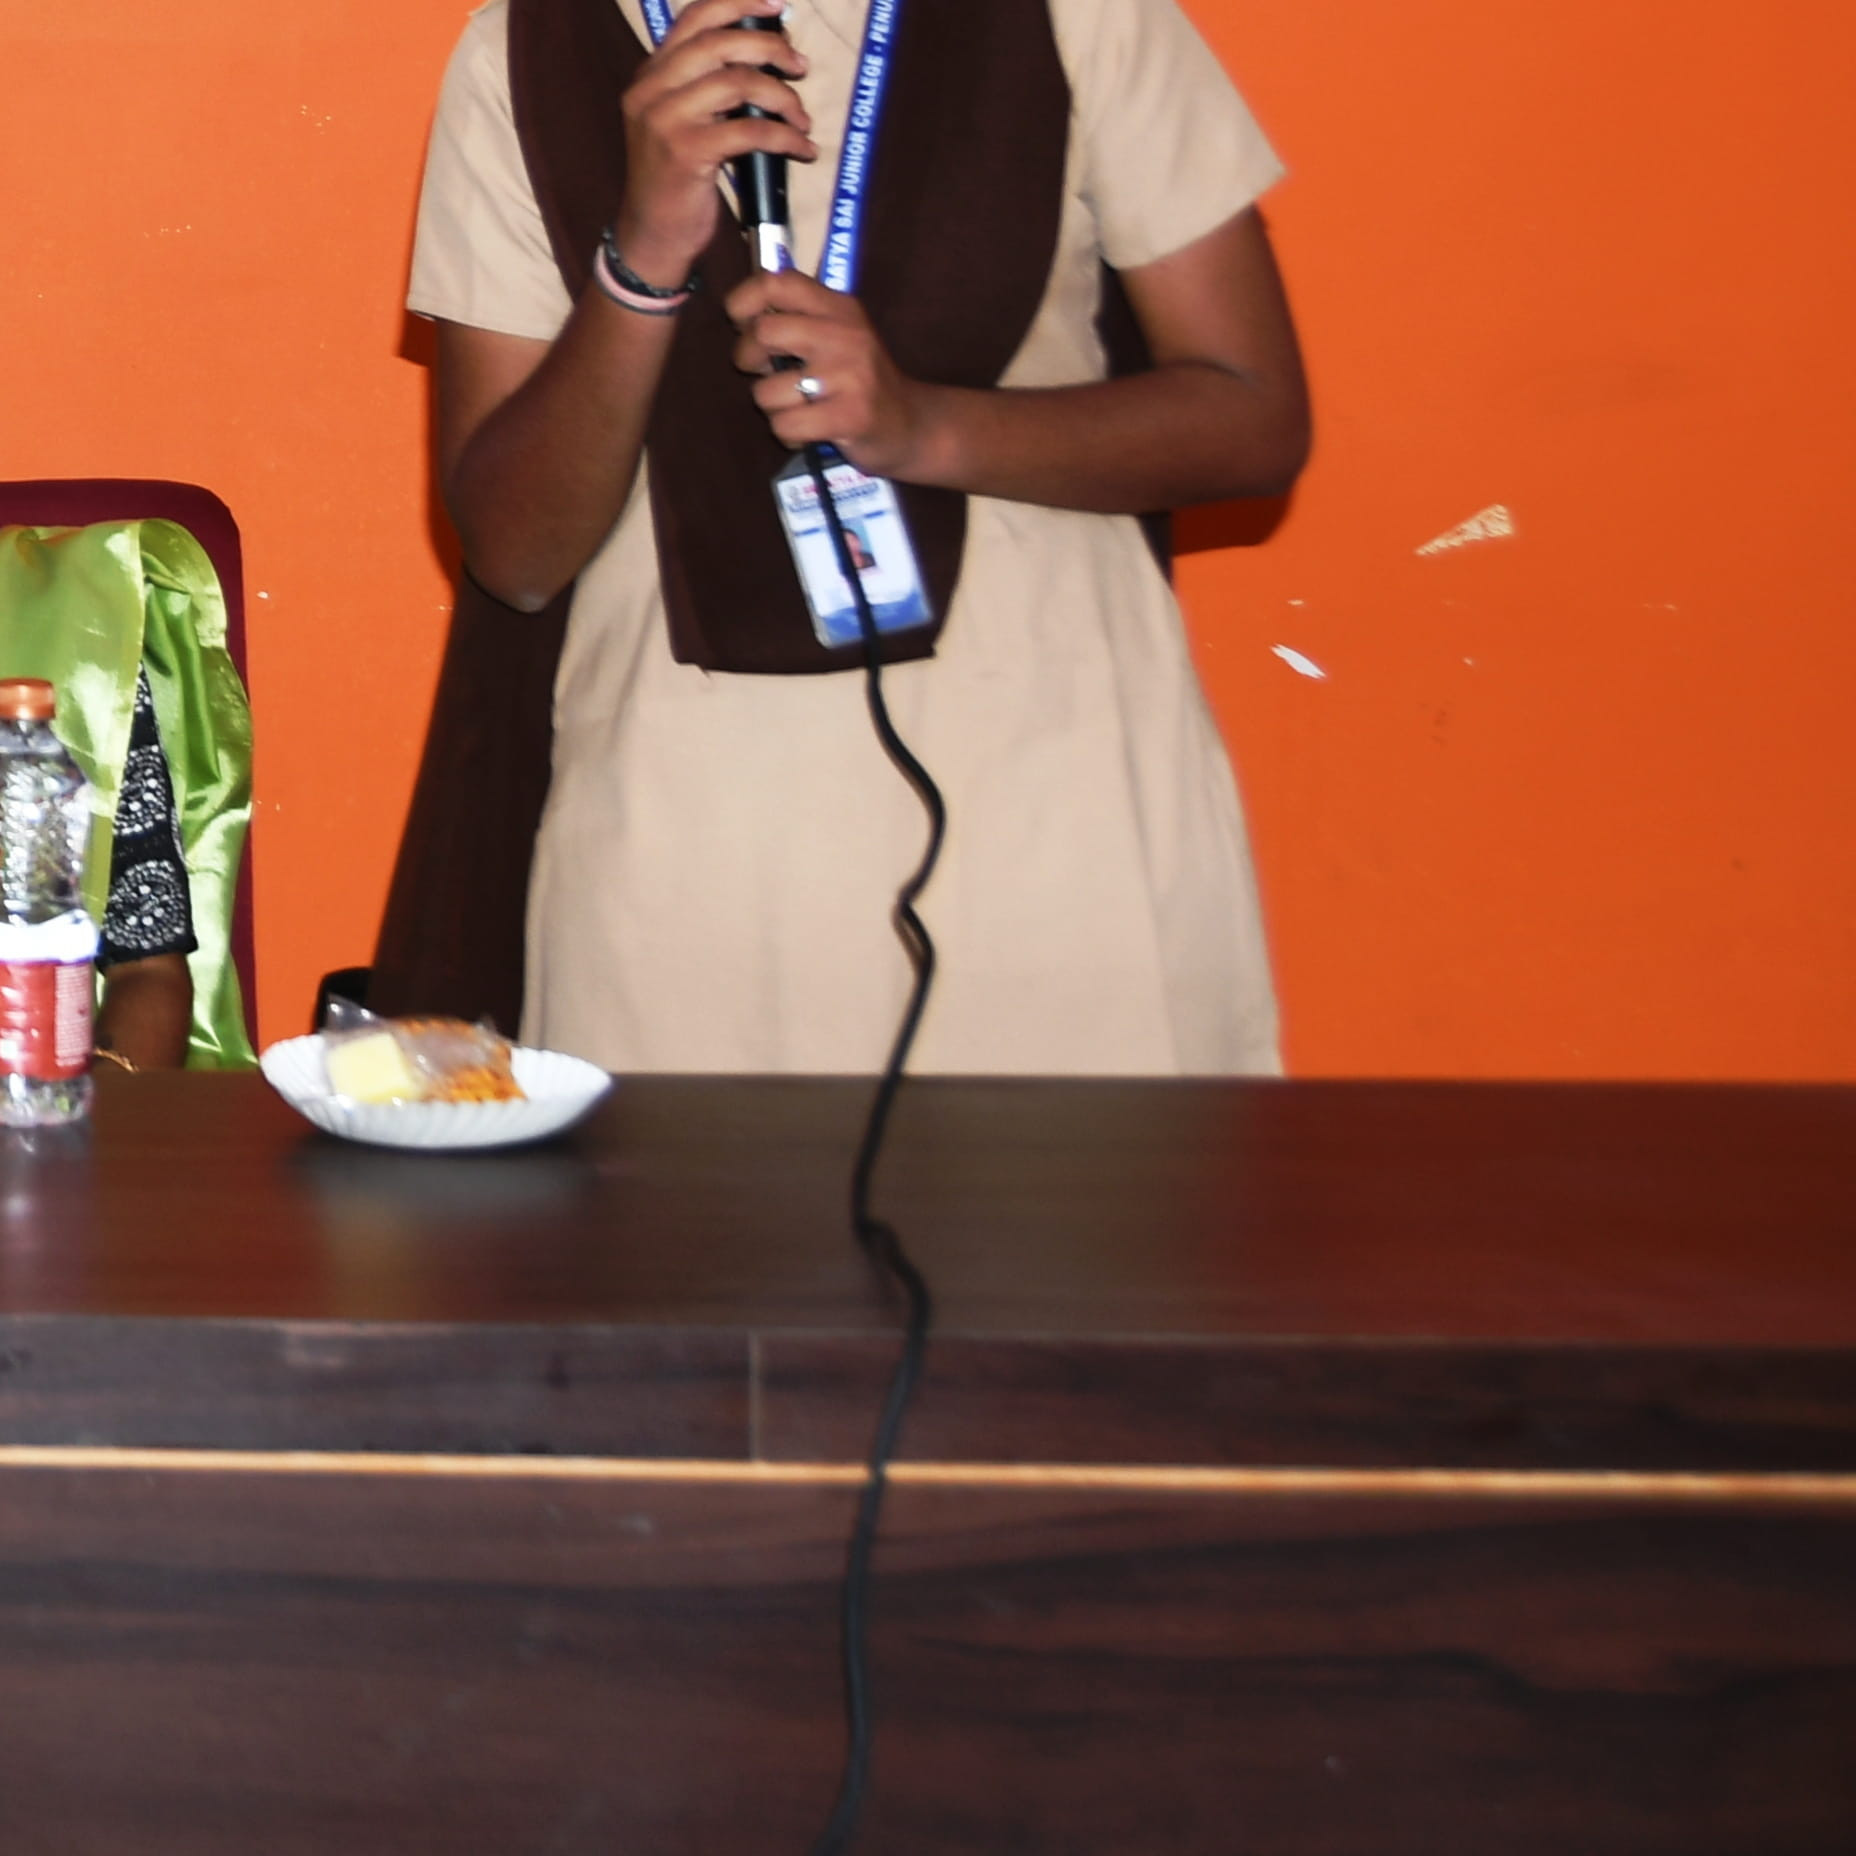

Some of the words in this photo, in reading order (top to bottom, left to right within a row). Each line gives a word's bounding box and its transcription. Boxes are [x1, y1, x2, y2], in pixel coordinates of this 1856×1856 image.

[854, 53, 886, 130] COLLEGE
[841, 132, 869, 194] JUNIOR
[834, 196, 856, 227] SAI
